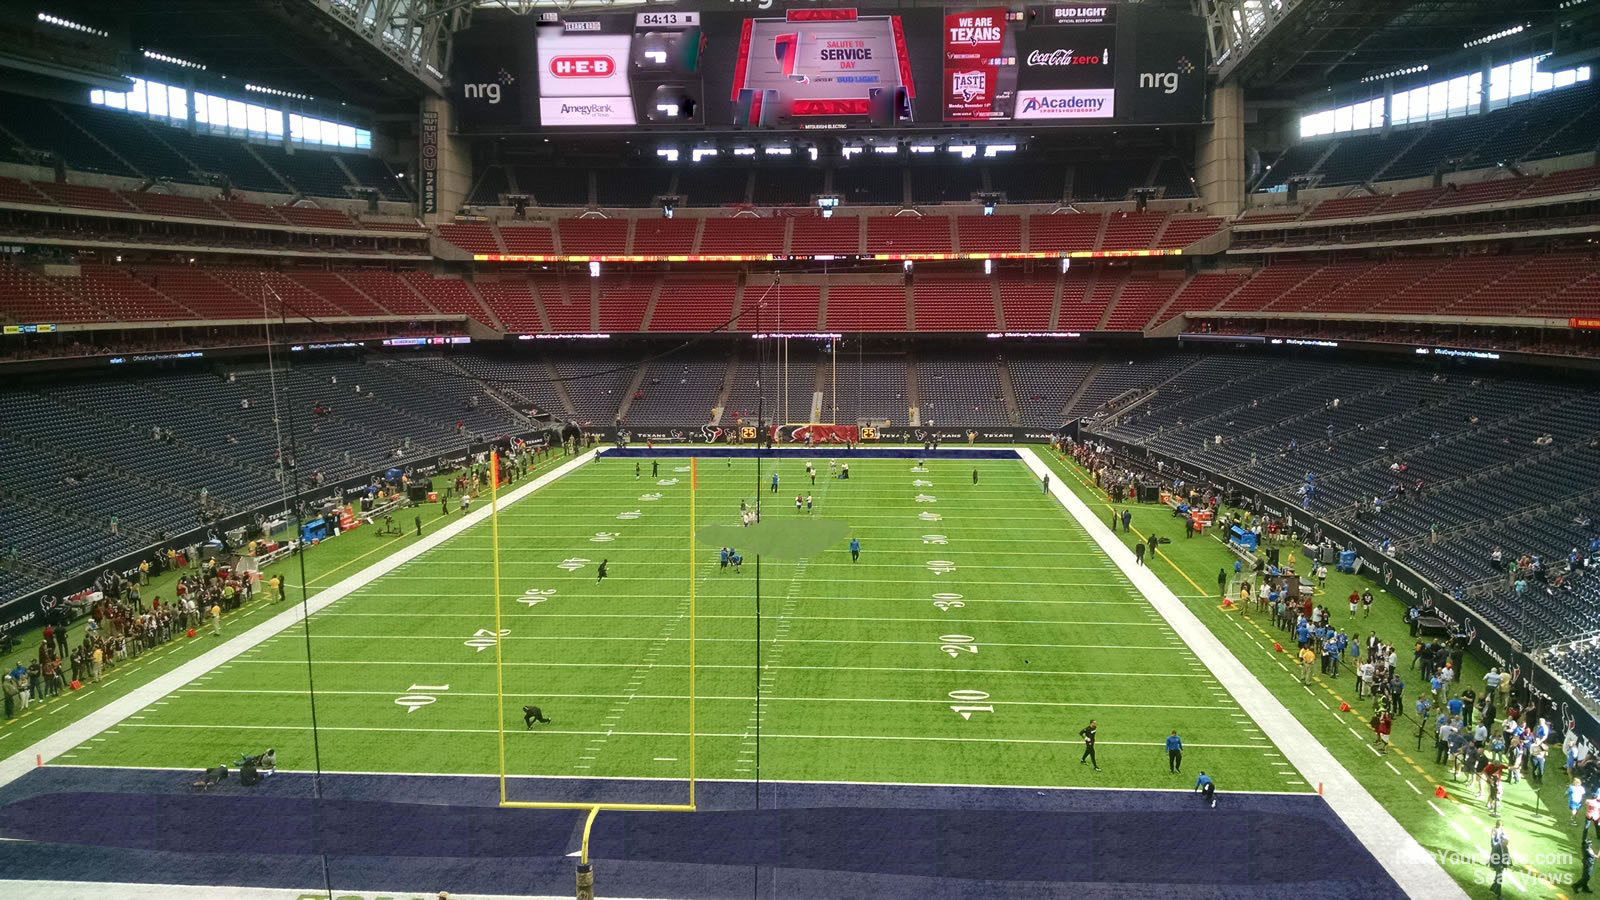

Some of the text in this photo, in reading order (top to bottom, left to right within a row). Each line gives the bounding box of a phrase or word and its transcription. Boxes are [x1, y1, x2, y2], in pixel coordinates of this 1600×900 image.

[1055, 8, 1106, 17] BUD LIGHT
[644, 15, 676, 24] 84:13
[960, 18, 992, 26] WE ARE
[950, 28, 1000, 41] TEXANS
[821, 49, 872, 60] SERVICE
[1072, 56, 1099, 64] zero
[954, 76, 984, 90] TASTE
[1140, 72, 1178, 94] nrg
[464, 84, 500, 104] nrg
[1040, 96, 1104, 110] Academy
[743, 429, 754, 438] 25
[1264, 505, 1282, 517] TEXANS
[1360, 556, 1380, 574] TEXANS
[1396, 579, 1418, 598] TEXANS
[0, 612, 35, 632] TEXANS
[1480, 640, 1505, 667] TEXANS
